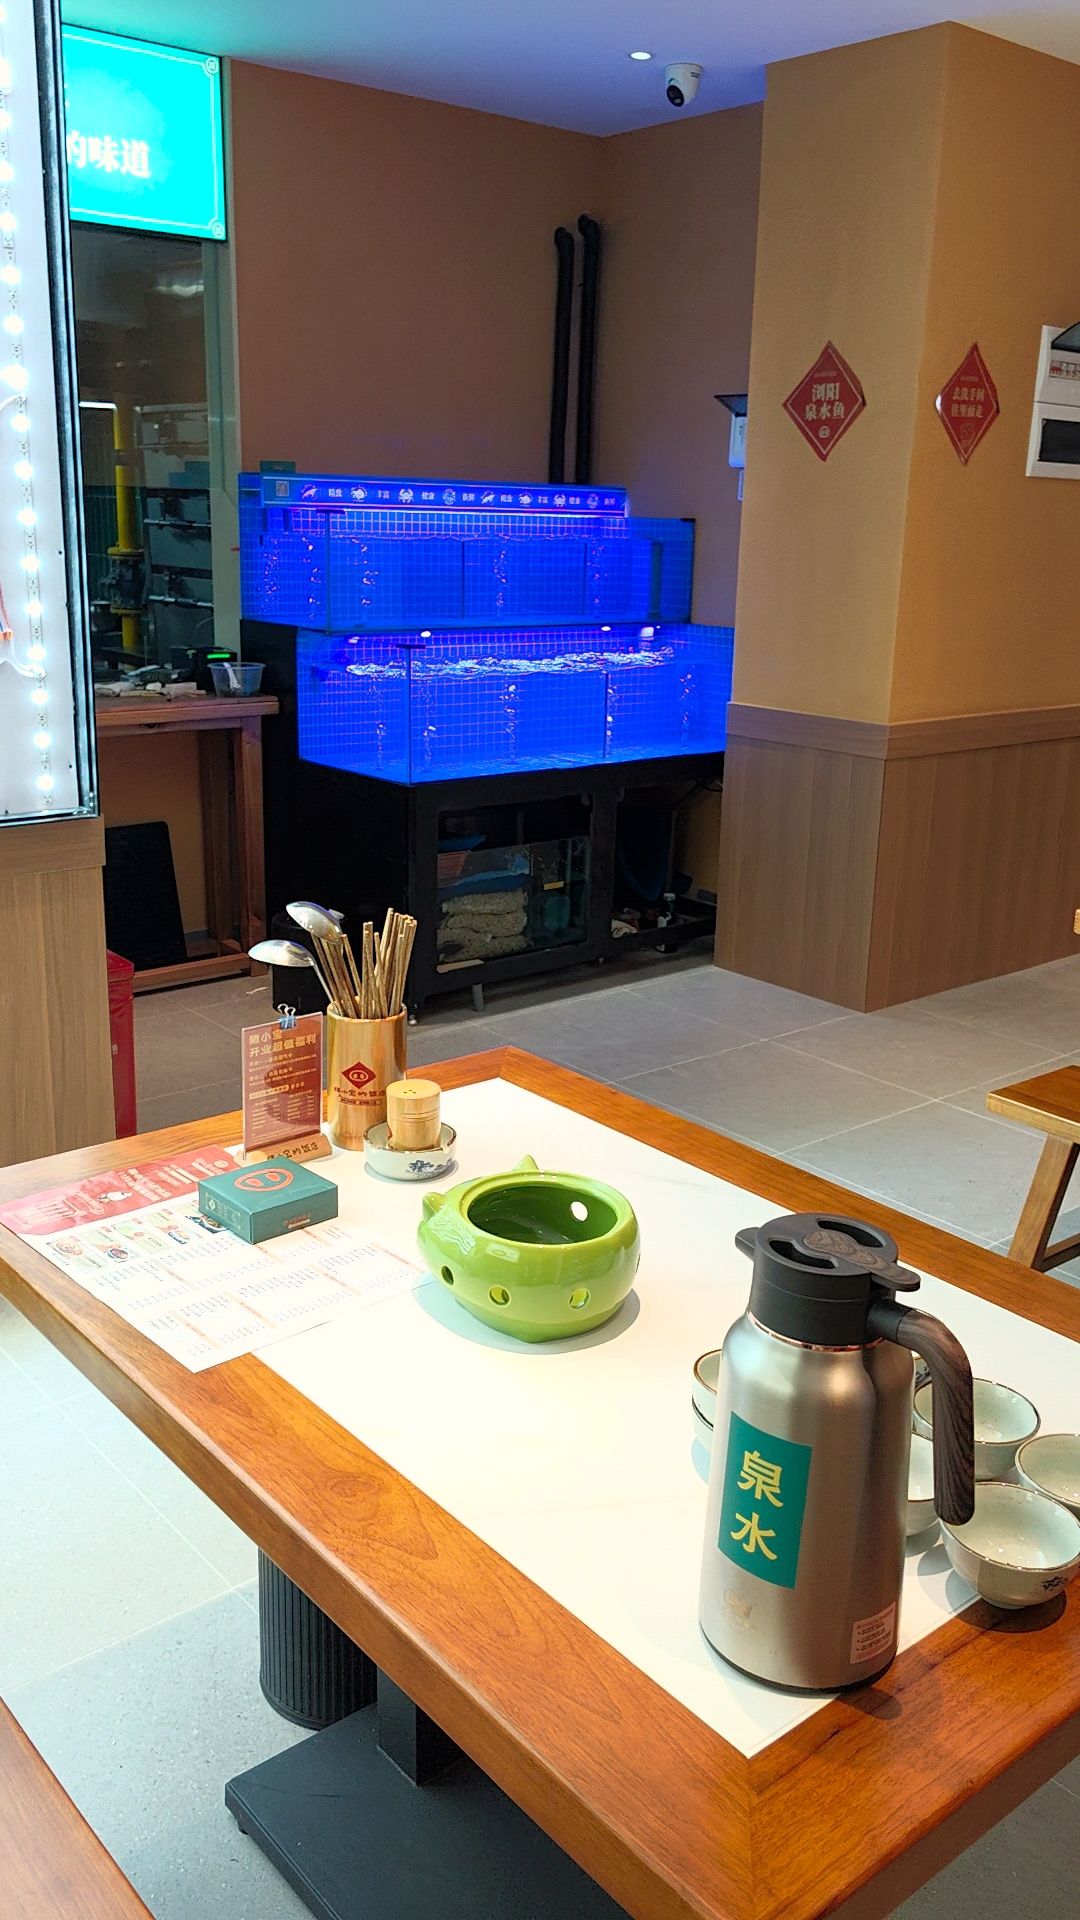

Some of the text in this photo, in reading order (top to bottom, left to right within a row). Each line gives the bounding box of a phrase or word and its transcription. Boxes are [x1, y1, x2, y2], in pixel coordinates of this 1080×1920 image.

[66, 130, 151, 178] 的味道
[812, 382, 840, 402] 浏阳
[805, 401, 845, 422] 泉水鱼
[249, 1033, 317, 1058] 开业超值福利
[730, 1450, 784, 1561] 泉水
